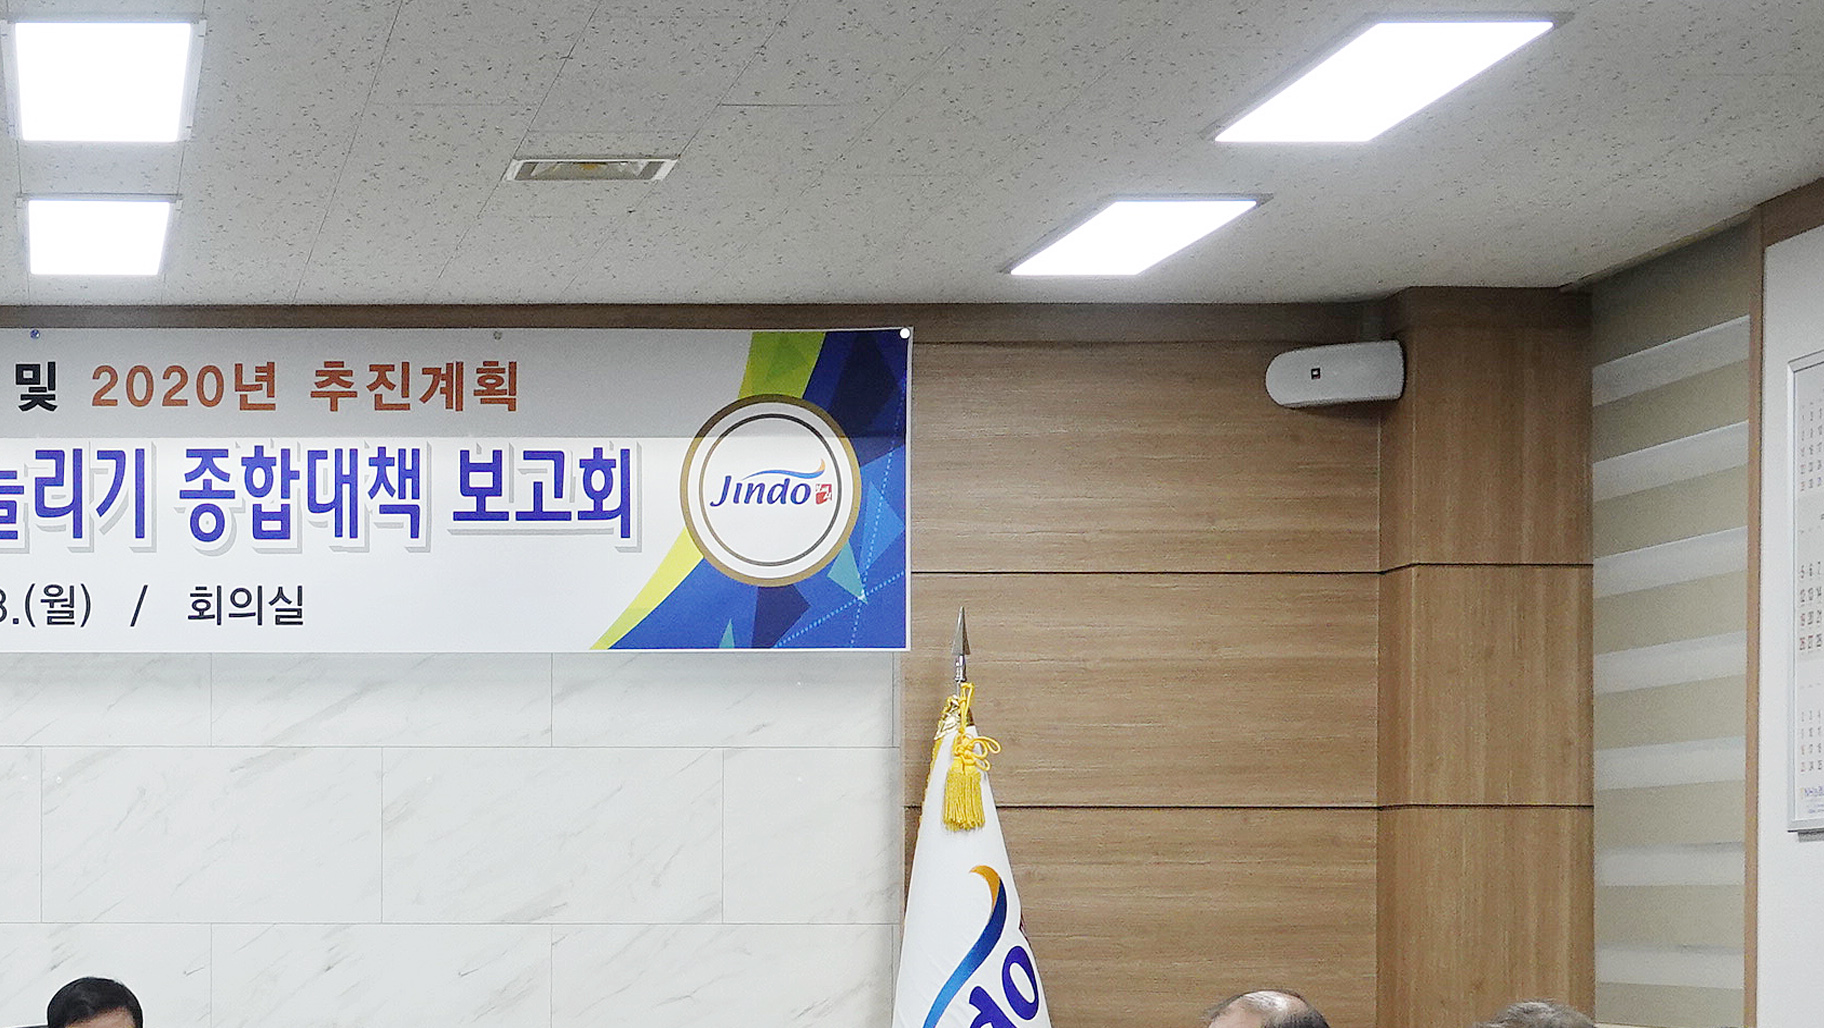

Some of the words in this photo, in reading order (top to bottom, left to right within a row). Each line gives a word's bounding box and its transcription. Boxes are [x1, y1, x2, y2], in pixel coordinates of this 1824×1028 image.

[15, 361, 58, 412] 및
[91, 361, 276, 411] 2020년
[310, 360, 518, 412] 추진계획
[179, 445, 421, 543] 종합대책
[452, 447, 631, 539] 보고회
[709, 475, 812, 507] Jindo
[187, 585, 304, 626] 회의실
